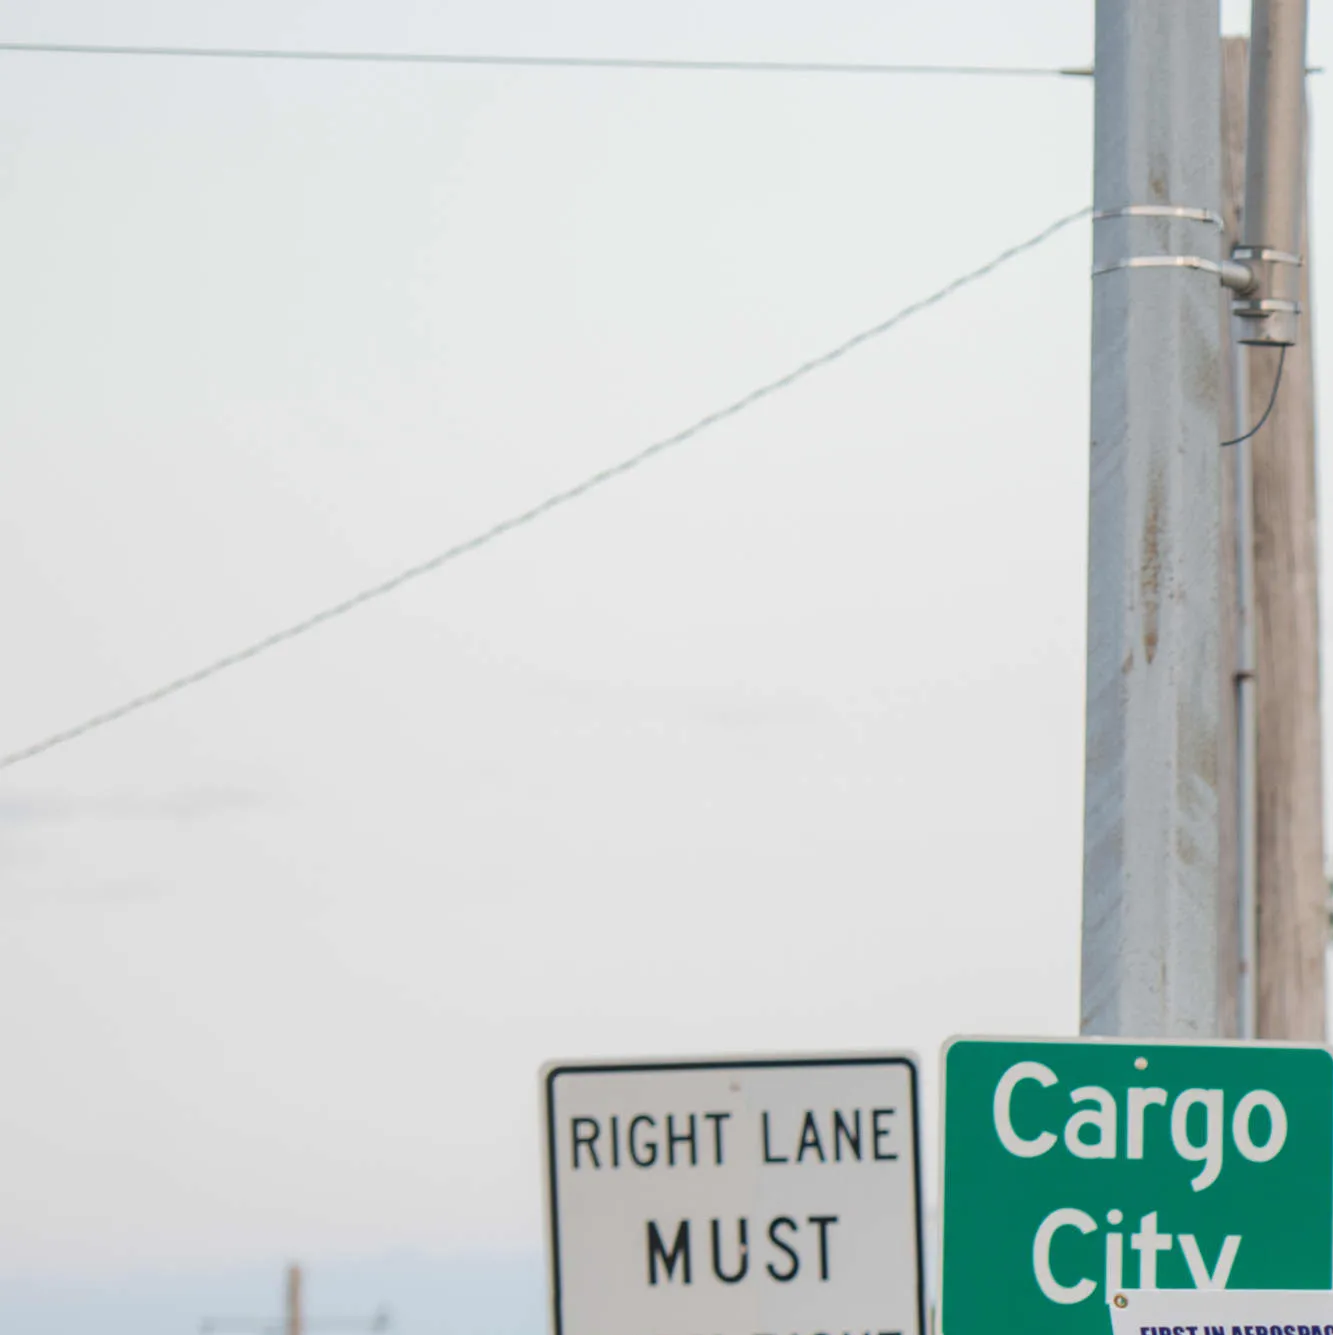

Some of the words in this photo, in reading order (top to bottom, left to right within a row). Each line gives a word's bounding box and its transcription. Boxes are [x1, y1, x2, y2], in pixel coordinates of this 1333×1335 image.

[570, 1113, 731, 1170] RIGHT
[761, 1108, 899, 1164] LANE
[992, 1060, 1288, 1191] Cargo
[645, 1215, 839, 1287] MUST
[1032, 1207, 1243, 1305] City
